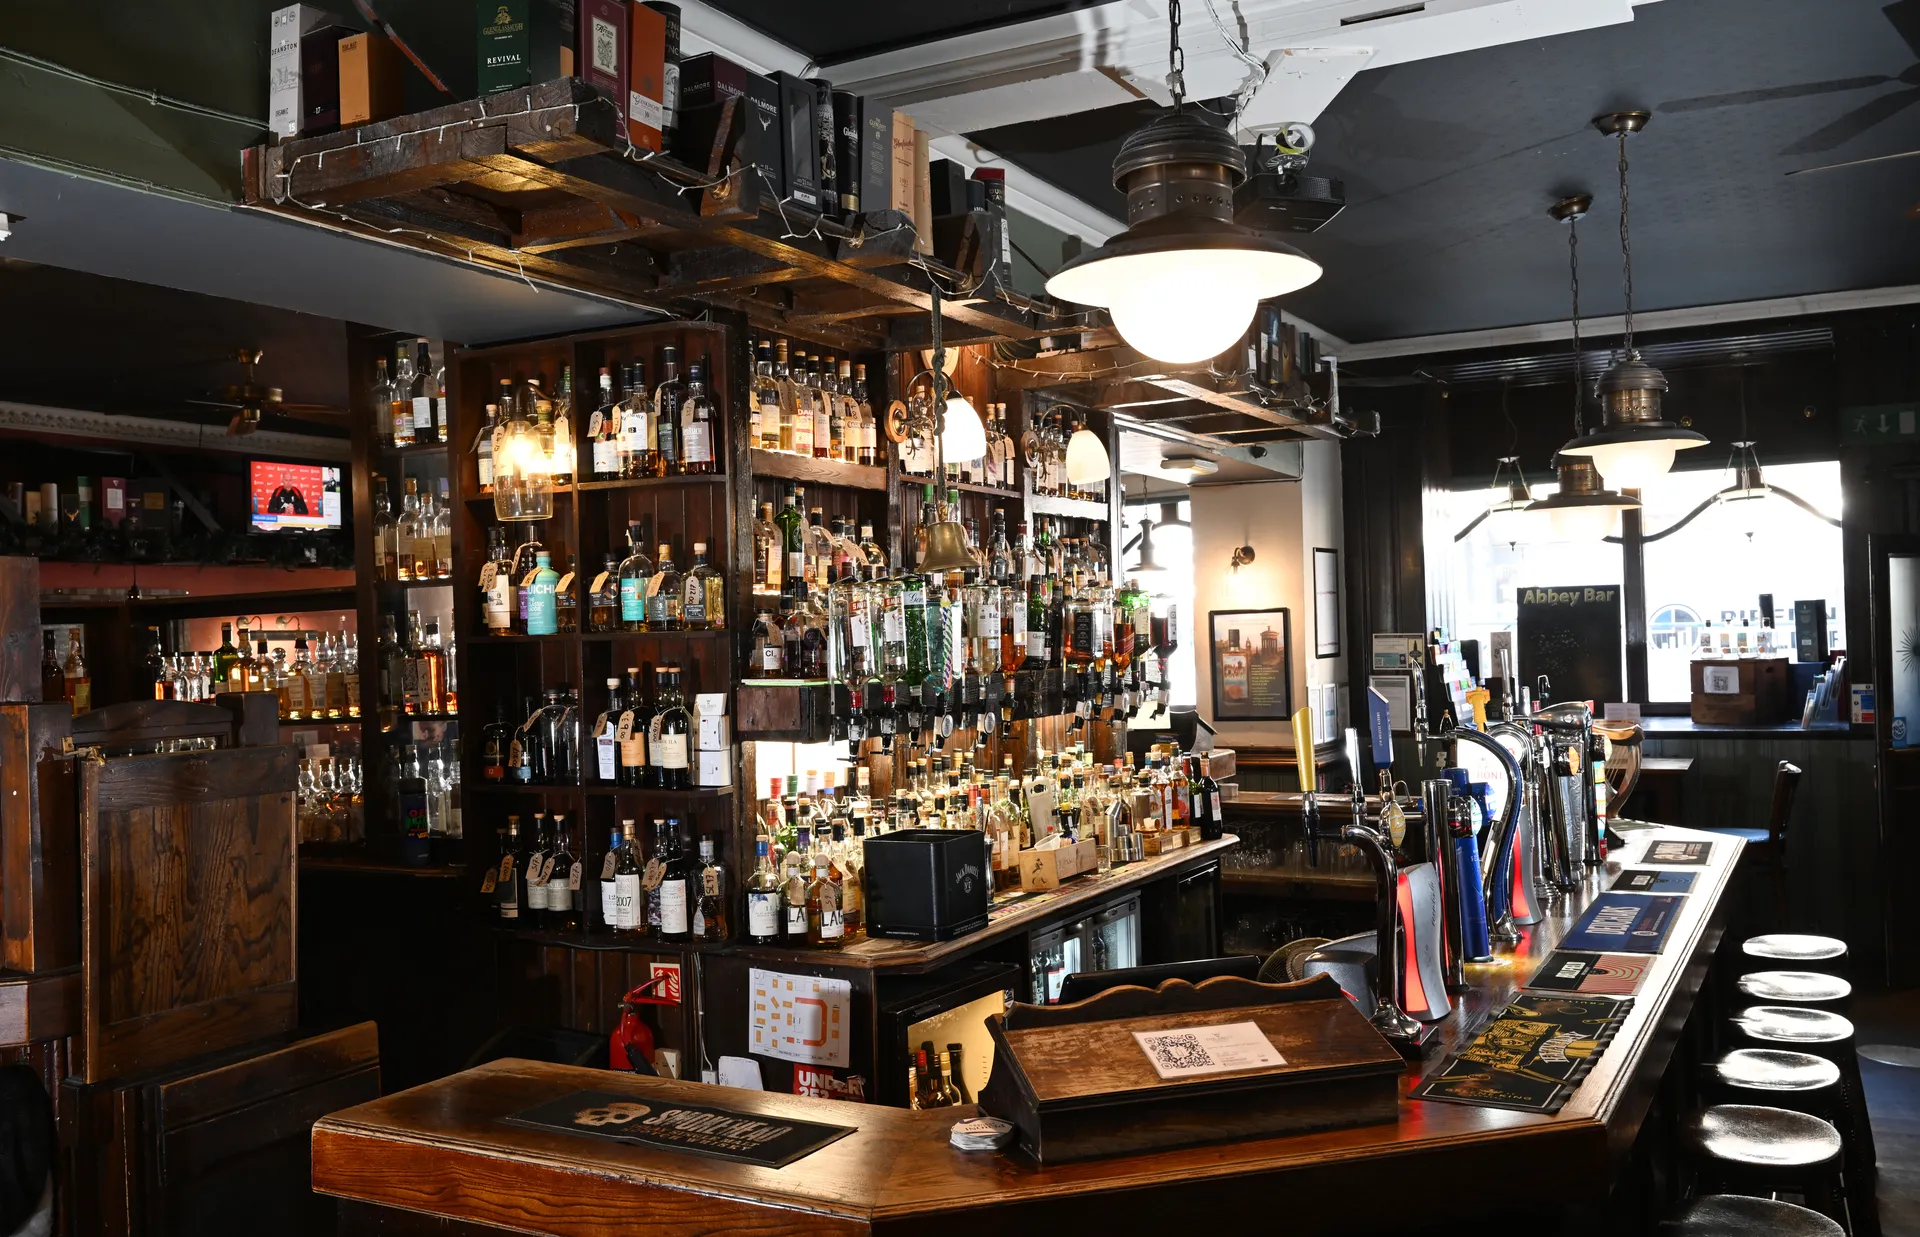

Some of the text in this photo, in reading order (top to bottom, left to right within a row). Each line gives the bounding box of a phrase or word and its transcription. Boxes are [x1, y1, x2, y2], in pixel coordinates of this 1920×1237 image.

[271, 42, 298, 56] DEANSTON
[487, 54, 521, 65] REVIVAL
[683, 81, 711, 93] DALMORE
[717, 81, 745, 97] DALMORE
[288, 123, 295, 132] 15
[1523, 588, 1615, 607] Abbey Bar
[1585, 905, 1641, 935] DEUCHARS
[642, 1109, 794, 1142] SMOKEHEAD
